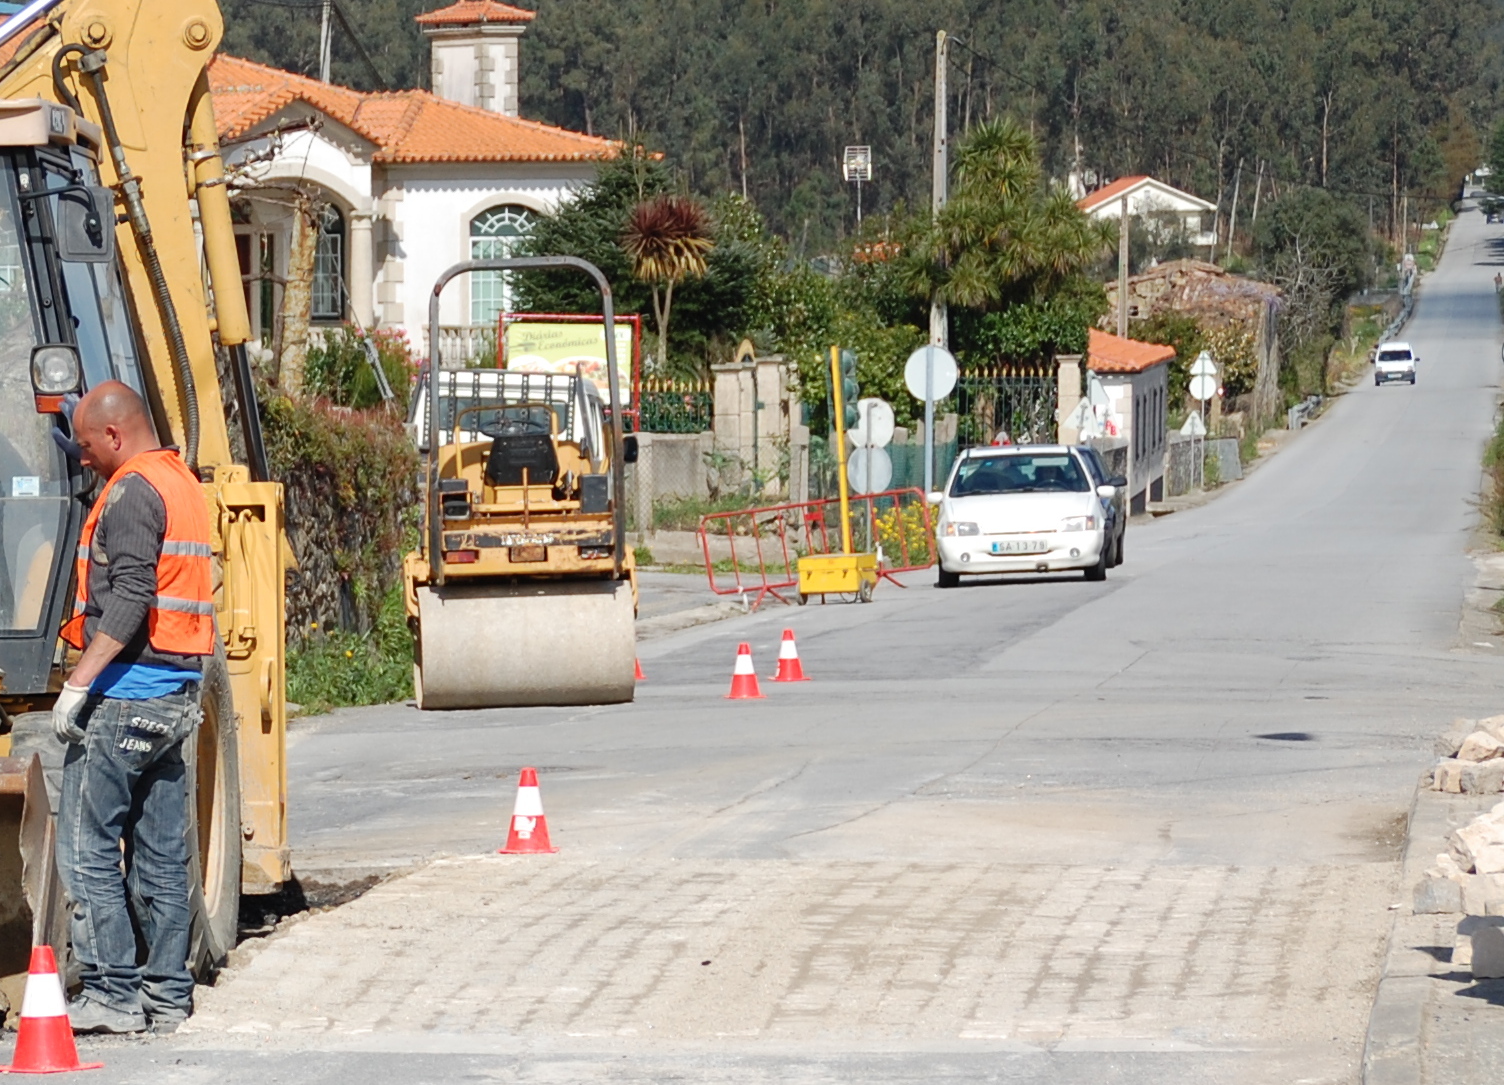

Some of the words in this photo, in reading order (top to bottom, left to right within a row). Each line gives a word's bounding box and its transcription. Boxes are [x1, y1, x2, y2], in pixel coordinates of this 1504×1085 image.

[522, 330, 563, 342] Diárias
[537, 337, 598, 351] Económicas
[120, 738, 152, 752] JEANS
